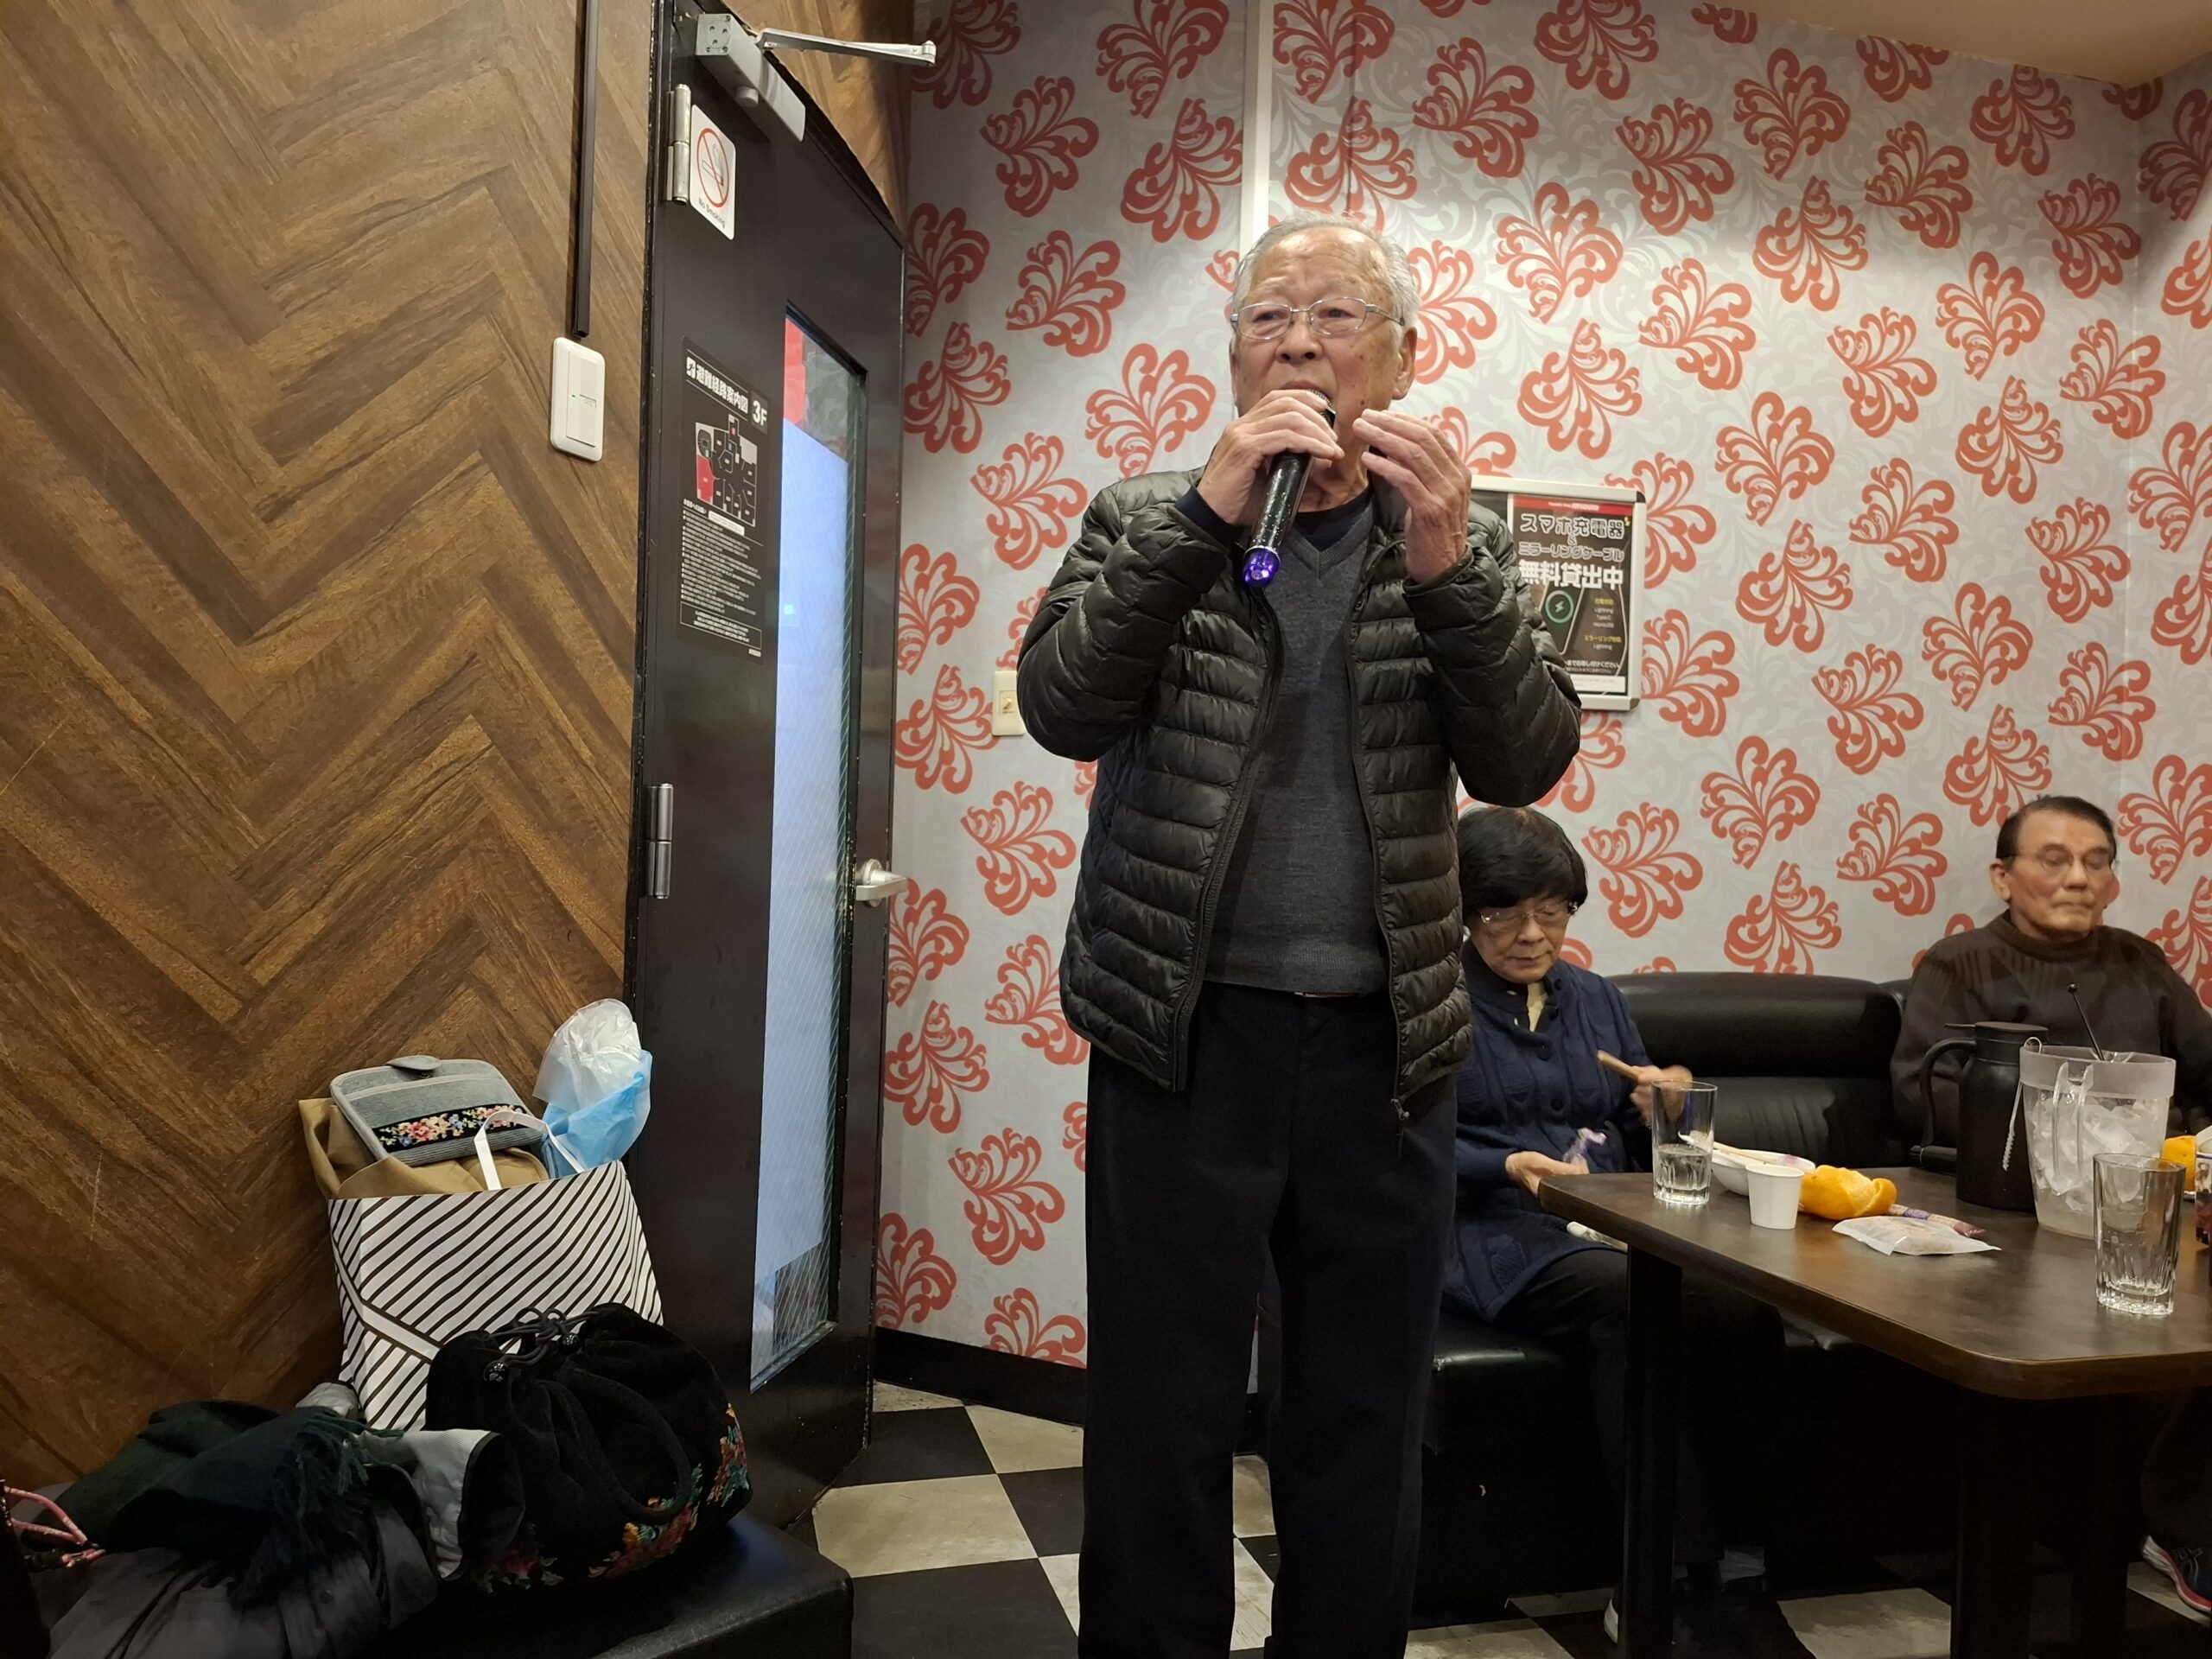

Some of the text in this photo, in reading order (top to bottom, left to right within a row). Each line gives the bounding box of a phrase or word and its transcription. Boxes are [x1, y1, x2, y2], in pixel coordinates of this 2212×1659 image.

[698, 197, 725, 229] No Smoking
[753, 400, 767, 426] 3F
[1520, 513, 1624, 539] スマホ充電器
[1518, 541, 1624, 563] ミラーリングケーブル
[1519, 559, 1624, 590] 無料貸出中
